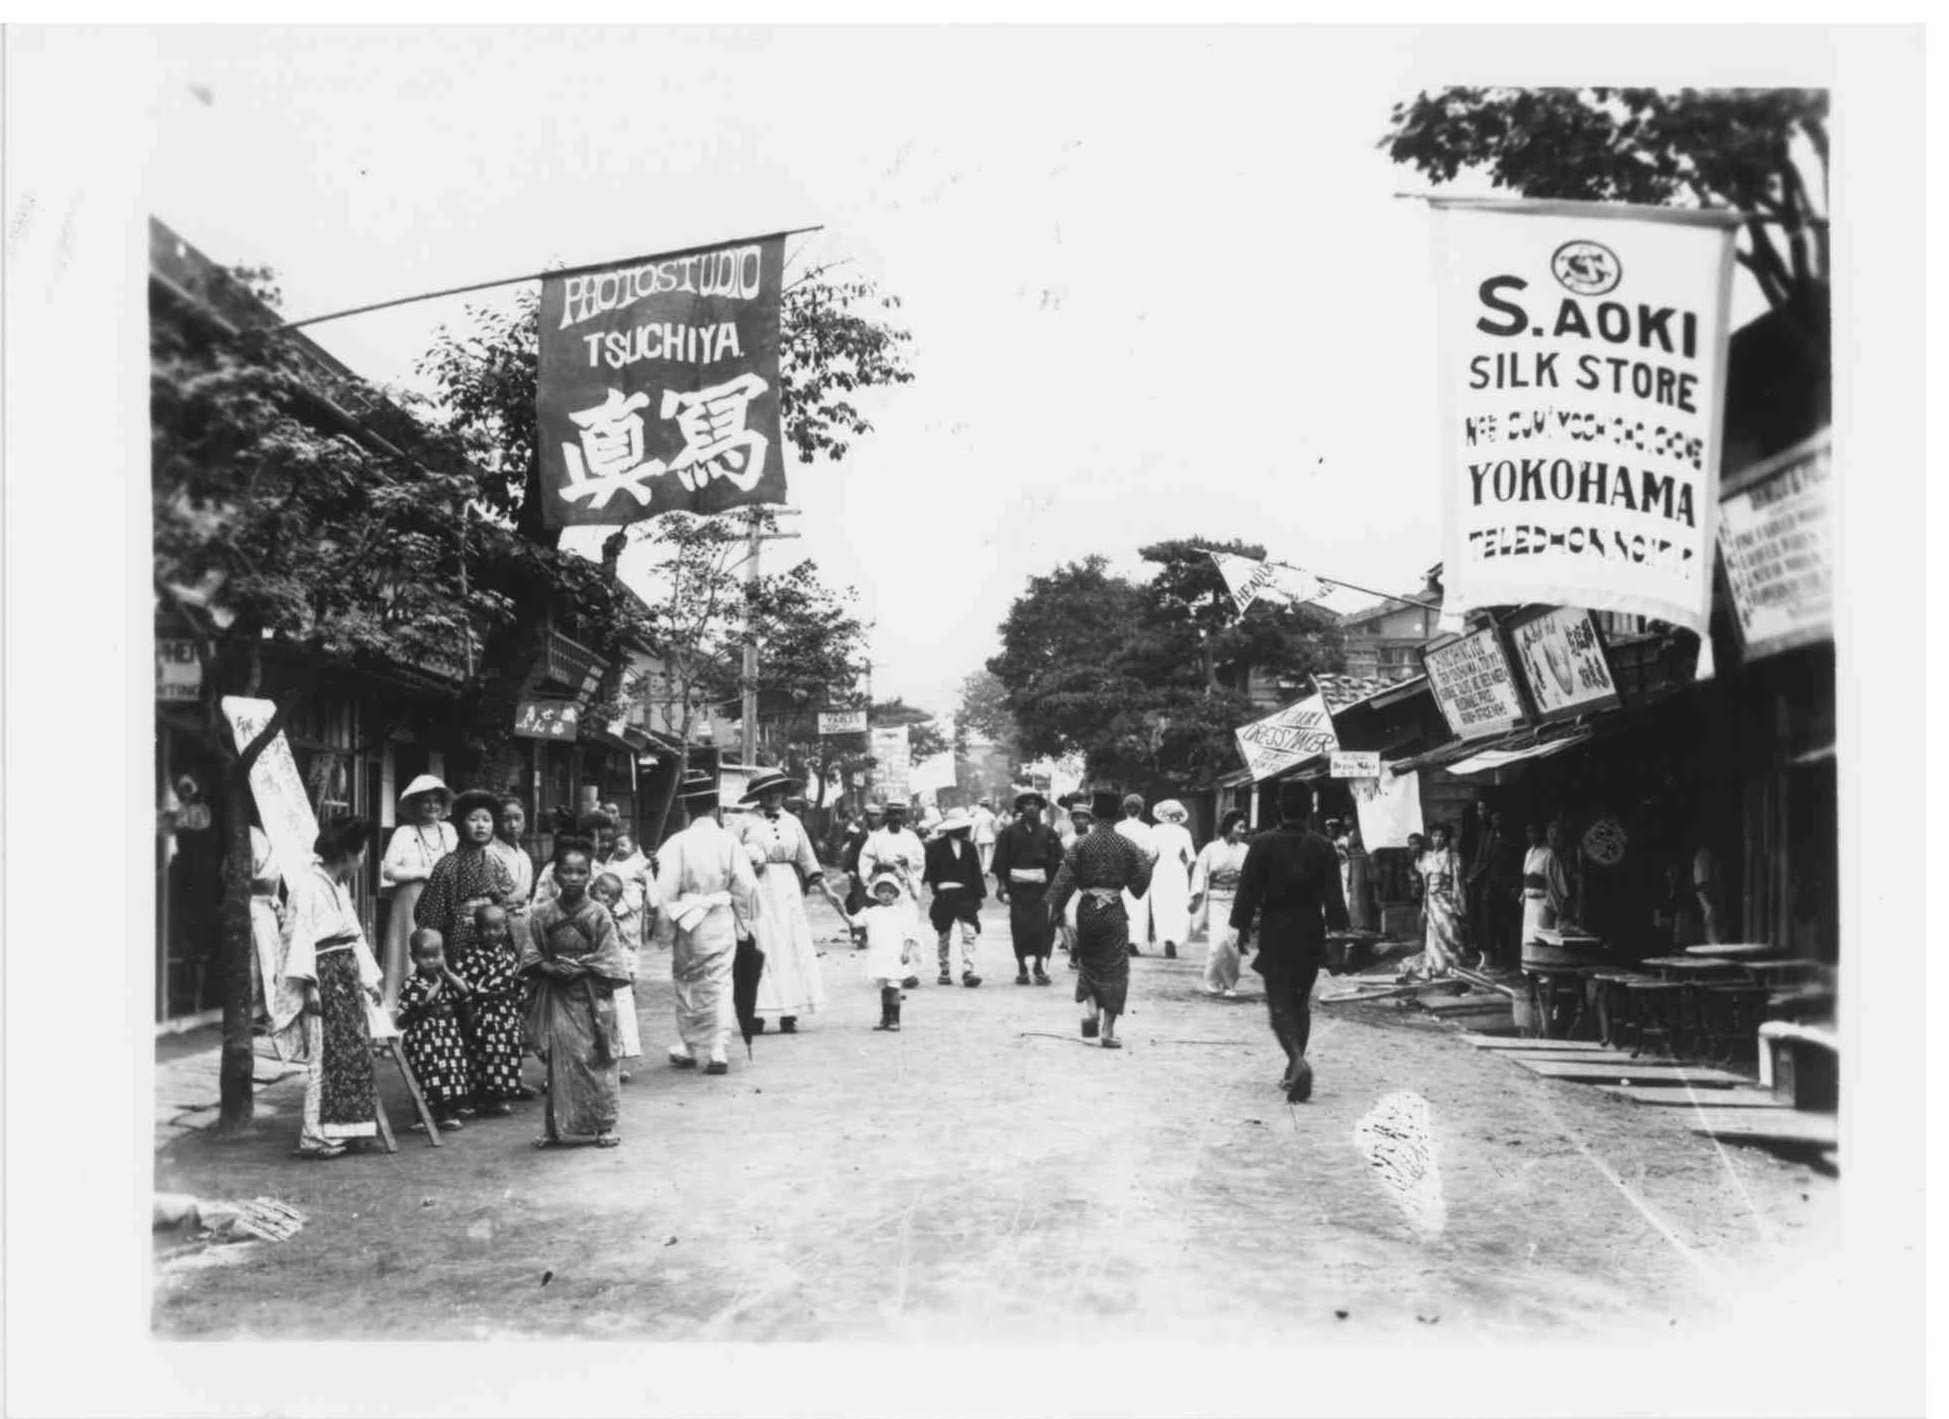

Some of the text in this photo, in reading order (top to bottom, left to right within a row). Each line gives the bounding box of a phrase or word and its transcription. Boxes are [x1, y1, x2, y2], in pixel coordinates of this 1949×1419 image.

[1468, 351, 1698, 414] SILK STORE
[1468, 458, 1696, 529] YOKOHAMA
